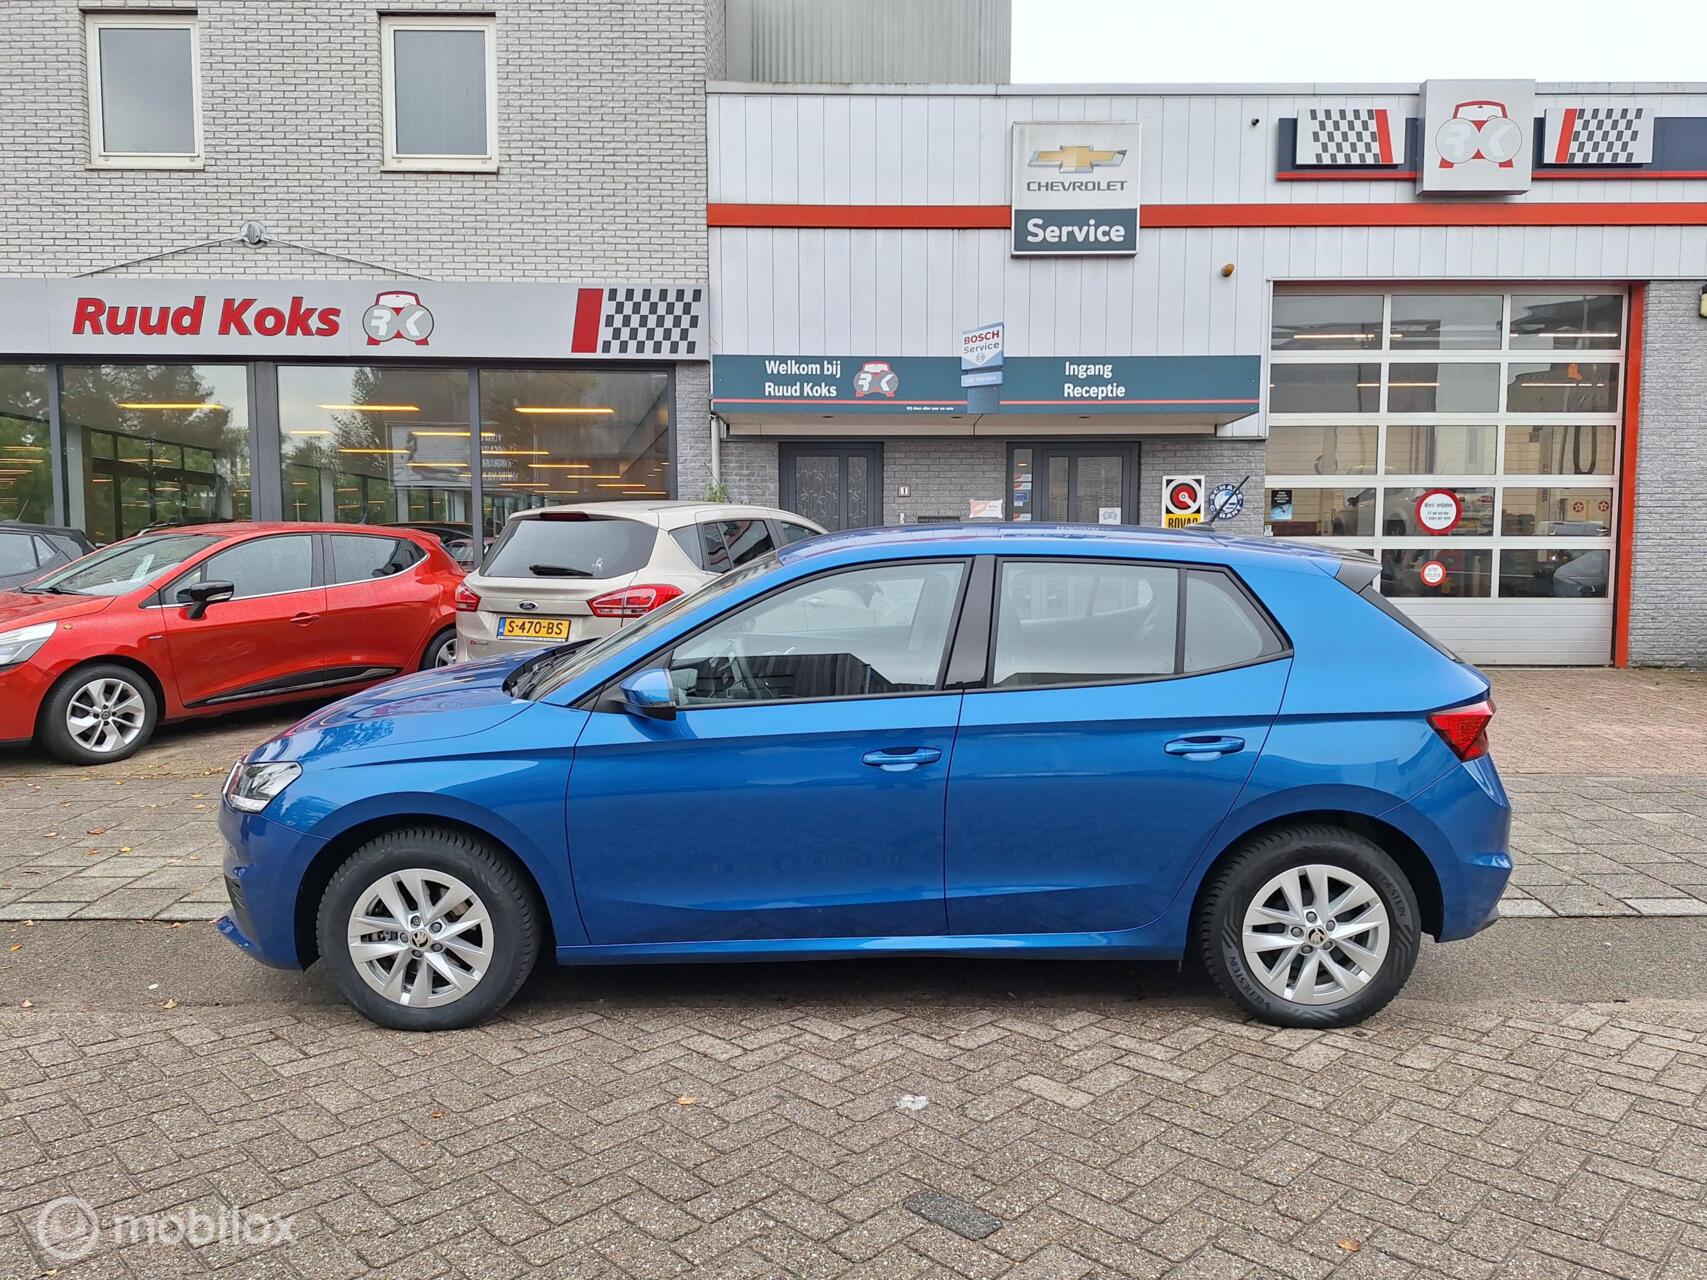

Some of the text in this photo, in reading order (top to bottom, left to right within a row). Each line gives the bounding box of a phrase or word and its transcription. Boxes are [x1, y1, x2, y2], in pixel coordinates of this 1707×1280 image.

[1026, 180, 1128, 192] CHEVROLET
[1026, 217, 1125, 243] Service
[72, 295, 342, 337] Ruud Koks
[963, 329, 1000, 345] BOSCH
[963, 342, 1000, 354] Service
[765, 360, 841, 378] Welkom bij
[1065, 361, 1113, 379] Ingang
[764, 381, 837, 397] Ruud Koks
[1063, 382, 1126, 400] Receptie
[507, 620, 564, 635] S-470-BS
